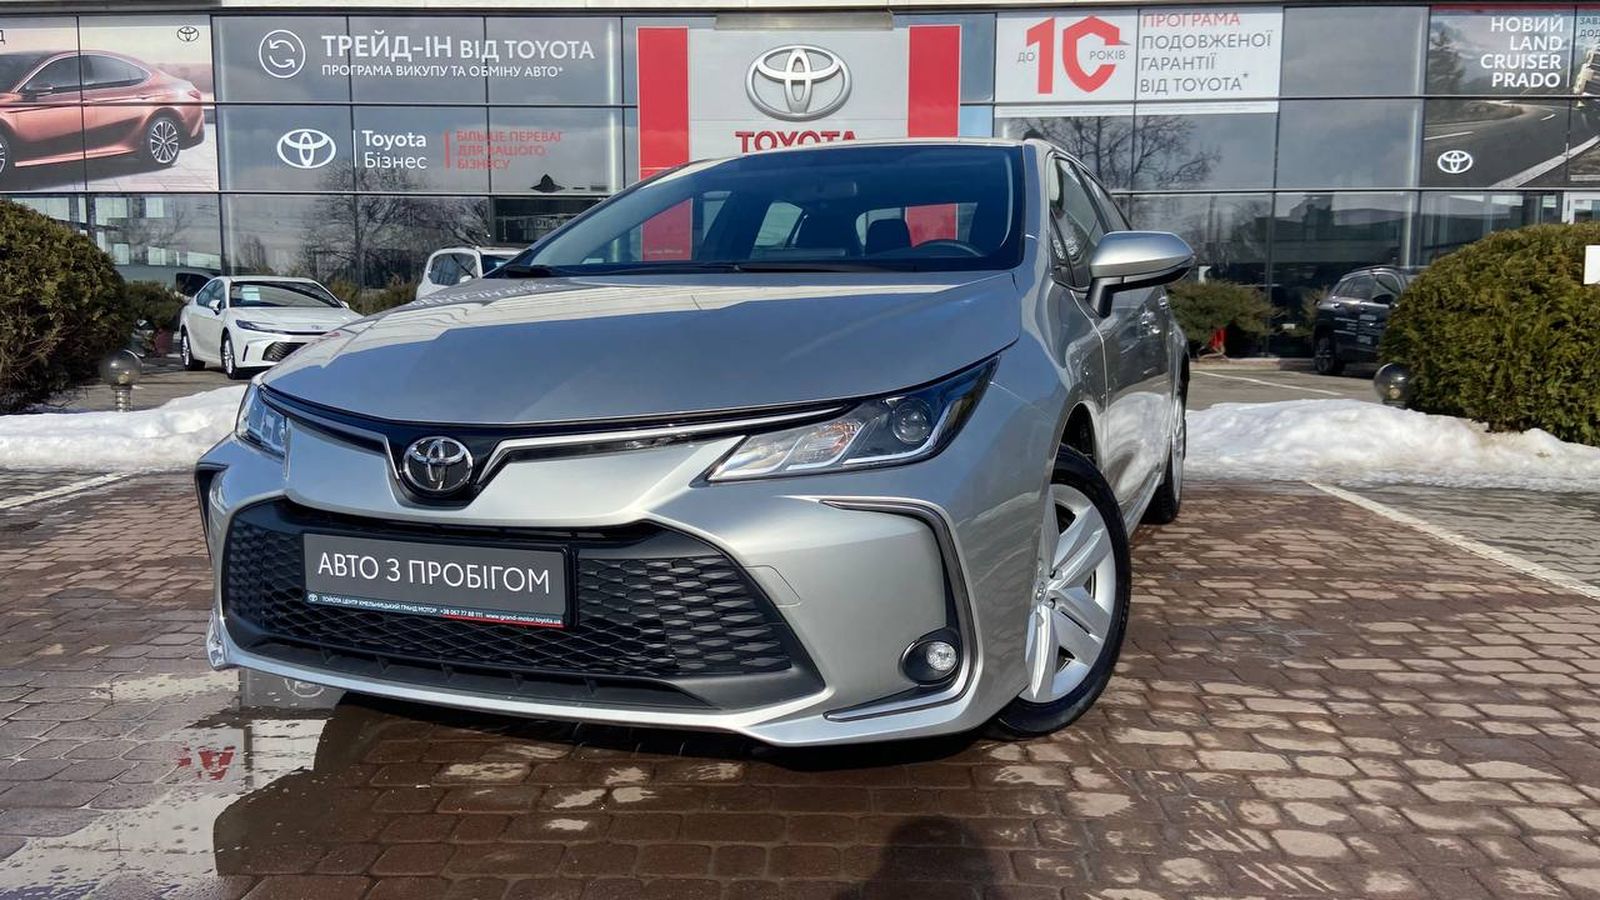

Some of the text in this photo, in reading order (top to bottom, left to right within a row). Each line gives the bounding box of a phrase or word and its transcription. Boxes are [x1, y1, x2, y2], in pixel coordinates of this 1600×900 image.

[1142, 13, 1241, 28] ПРОГРАМА
[1491, 15, 1563, 32] НОВИЙ
[322, 31, 595, 64] ТРЕЙД-ІН ВІД TOYOTA
[1142, 30, 1272, 50] ПОДОВЖЕНОЇ
[1510, 36, 1562, 51] LAND
[1017, 52, 1035, 63] ДО
[1089, 50, 1126, 60] РОКІВ
[1140, 53, 1217, 71] ГАРАНТІЇ
[1481, 54, 1561, 69] CRUISER
[322, 65, 393, 77] ПРОГРАМА
[396, 66, 448, 77] ВИКУПУ
[452, 66, 466, 77] ТА
[469, 66, 522, 77] ОБМІНУ
[1140, 79, 1168, 95] ВІД
[1492, 73, 1560, 88] PRADO
[362, 130, 427, 149] Toyota
[457, 131, 563, 142] БІЛЬШЕ ПЕРЕВАГ
[365, 151, 427, 169] Бізнес
[318, 552, 379, 580] АВТО
[409, 560, 550, 594] ПРОБІГОМ
